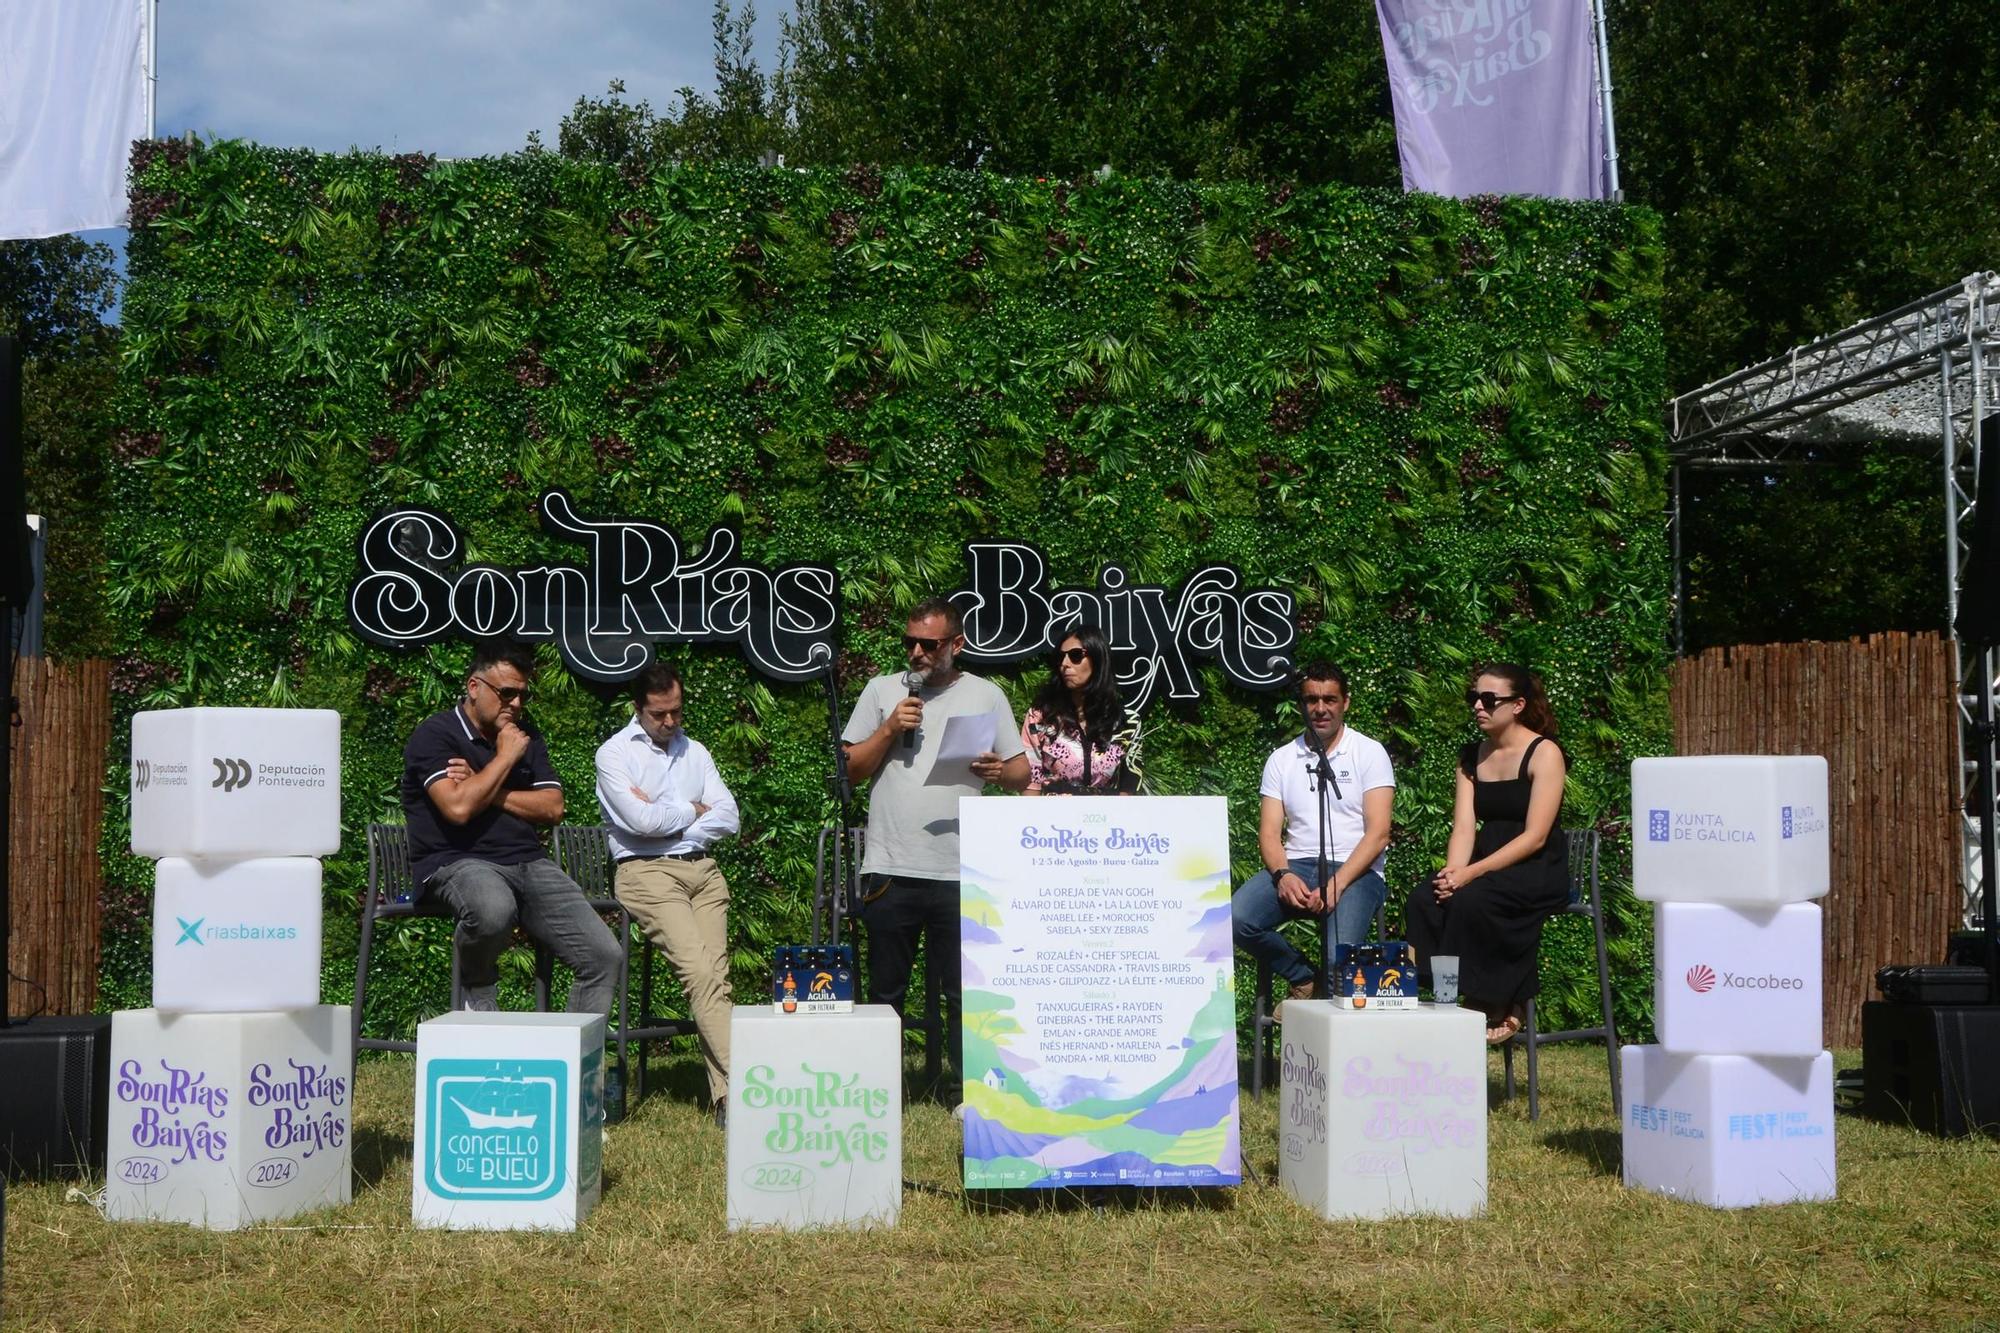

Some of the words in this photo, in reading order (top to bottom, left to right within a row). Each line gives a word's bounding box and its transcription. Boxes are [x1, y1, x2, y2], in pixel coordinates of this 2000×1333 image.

[351, 491, 835, 679] SonRías
[949, 544, 1294, 716] Baixas
[258, 763, 326, 776] Deputación
[258, 776, 326, 788] Pontevedra
[1082, 814, 1107, 824] 2024
[1674, 813, 1724, 826] XUNTA
[1020, 825, 1098, 854] SonRías
[1105, 828, 1170, 857] Baixas
[1674, 828, 1695, 840] DE
[1697, 829, 1756, 843] GALICIA
[1054, 858, 1066, 866] de
[1067, 858, 1098, 868] Agosto
[1103, 858, 1126, 866] Bueu
[1131, 857, 1159, 866] Galiza
[1039, 888, 1051, 897] LA
[1054, 888, 1085, 898] OREJA
[1088, 888, 1101, 897] DE
[1103, 888, 1124, 897] VAN
[1126, 888, 1154, 897] GOGH
[1011, 898, 1051, 909] ÁLVARO
[1053, 901, 1067, 909] DE
[1069, 901, 1096, 910] LUNA
[1104, 901, 1117, 910] LA
[1119, 901, 1132, 910] LA
[1134, 901, 1159, 909] LOVE
[1161, 901, 1183, 909] YOU
[1040, 914, 1076, 922] ANABEL
[1078, 914, 1094, 922] LEE
[1102, 914, 1155, 922] MOROCHOS
[1046, 926, 1081, 935] SABELA
[1089, 926, 1112, 935] SEXY
[1114, 926, 1149, 935] ZEBRAS
[1036, 949, 1083, 960] ROZALÉN
[1005, 964, 1039, 973] FILLAS
[1041, 964, 1054, 973] DE
[1056, 963, 1117, 973] CASSANDRA
[1125, 964, 1160, 973] TRAVIS
[1161, 964, 1192, 973] BIRDS
[992, 977, 1017, 986] COOL
[1019, 976, 1051, 986] NENAS
[1059, 976, 1111, 986] GILIPOJAZZ
[1118, 976, 1131, 985] LA
[1132, 974, 1157, 985] ÉLITE
[1164, 976, 1205, 985] MUERDO
[1723, 972, 1804, 990] Xacobeo
[1036, 1002, 1114, 1012] TANXUGUEIRAS
[1122, 1002, 1163, 1011] RAYDEN
[1037, 1015, 1087, 1025] GINEBRAS
[1095, 1015, 1115, 1024] THE
[1117, 1015, 1163, 1024] RAPANTS
[1043, 1028, 1076, 1038] EMLAN
[1083, 1028, 1122, 1038] GRANDE
[1124, 1028, 1157, 1037] AMORE
[1039, 1040, 1061, 1050] INÉS
[1062, 1041, 1109, 1050] HERNAND
[1116, 1040, 1161, 1050] MARLENA
[1045, 1054, 1087, 1063] MONDRA
[1095, 1054, 1111, 1063] MR.
[1113, 1054, 1157, 1063] KILOMBO
[1283, 1042, 1327, 1102] SonRías
[1343, 1053, 1477, 1106] SonRías
[117, 1058, 229, 1118] SonRías
[248, 1057, 346, 1110] SonRías
[742, 1062, 889, 1118] SonRías
[1290, 1088, 1326, 1144] Baixas
[1631, 1104, 1668, 1133] FEST
[1673, 1112, 1693, 1123] FEST
[1786, 1112, 1809, 1123] FEST
[265, 1107, 345, 1159] Baixas
[1361, 1100, 1477, 1154] Baixas
[1673, 1125, 1705, 1140] GALICIA
[1728, 1113, 1778, 1140] FEST
[1785, 1125, 1824, 1137] GALICIA
[132, 1107, 227, 1165] Baixas
[765, 1112, 889, 1169] Baixas
[448, 1135, 539, 1155] CONCELLO
[124, 1162, 159, 1181] 2024
[256, 1163, 291, 1182] 2024
[457, 1158, 475, 1173] DE
[481, 1157, 538, 1181] BUEU
[753, 1169, 802, 1186] 2024
